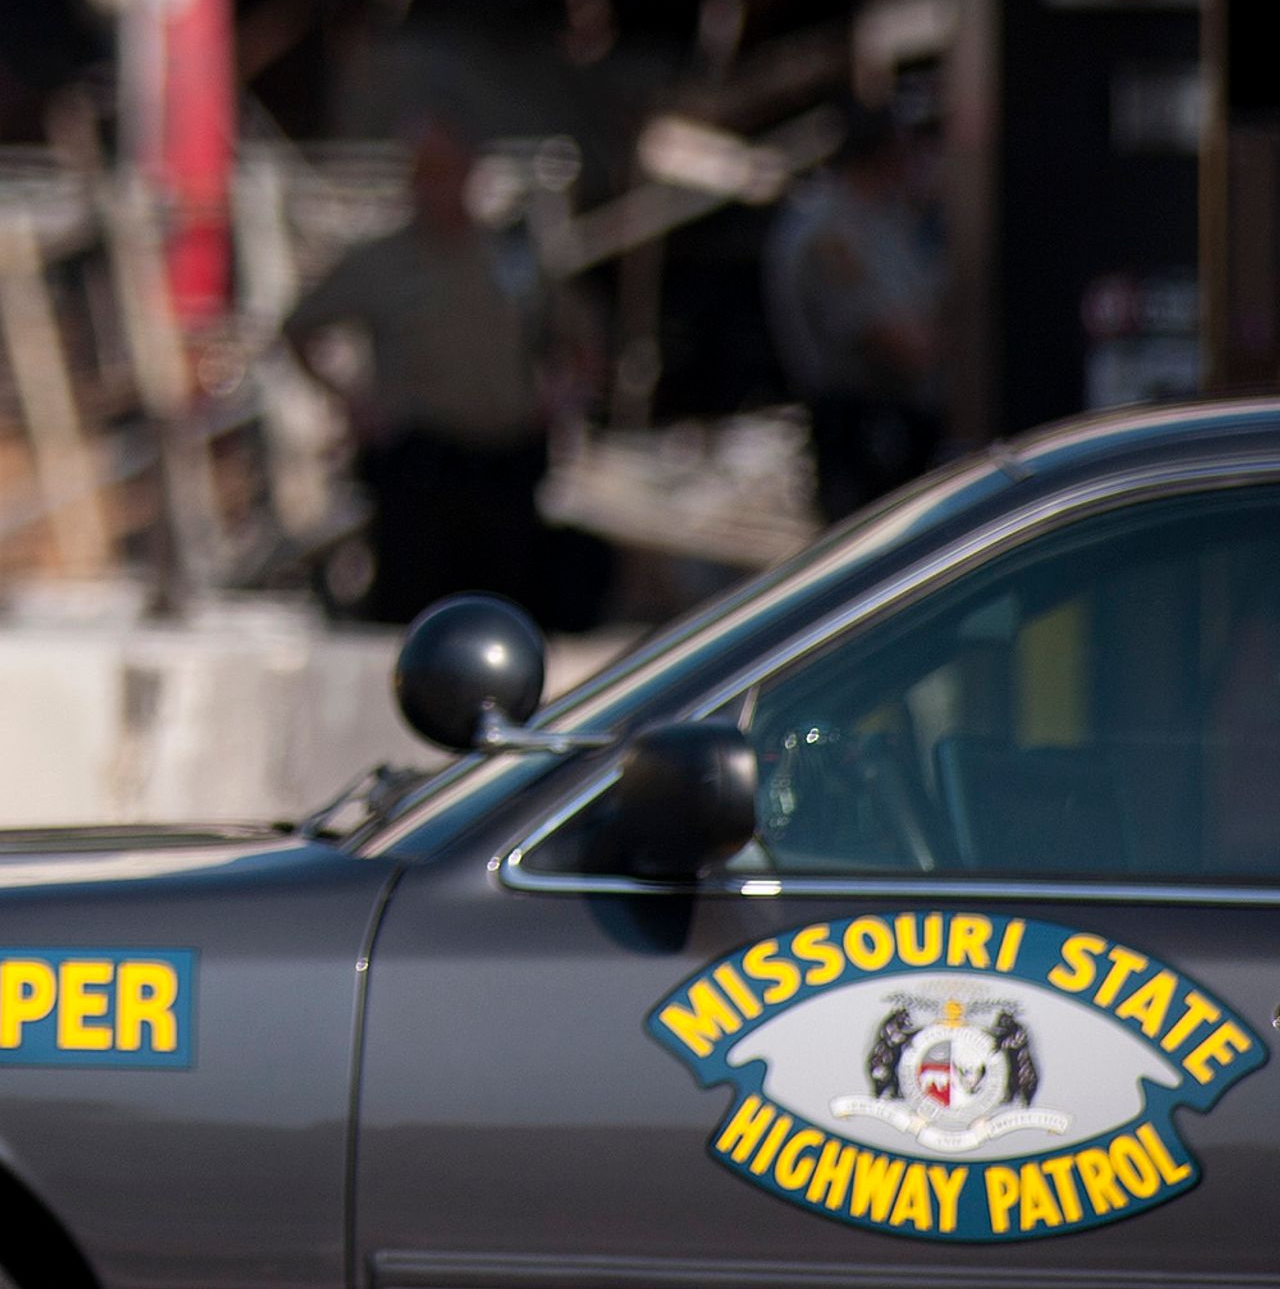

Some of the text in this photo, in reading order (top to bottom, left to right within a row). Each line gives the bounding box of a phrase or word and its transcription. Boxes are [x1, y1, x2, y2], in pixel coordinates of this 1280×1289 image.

[657, 911, 1028, 1059] MISSOURI
[1046, 933, 1252, 1085] STATE
[714, 1093, 1192, 1234] HIGHWAY PATROL
